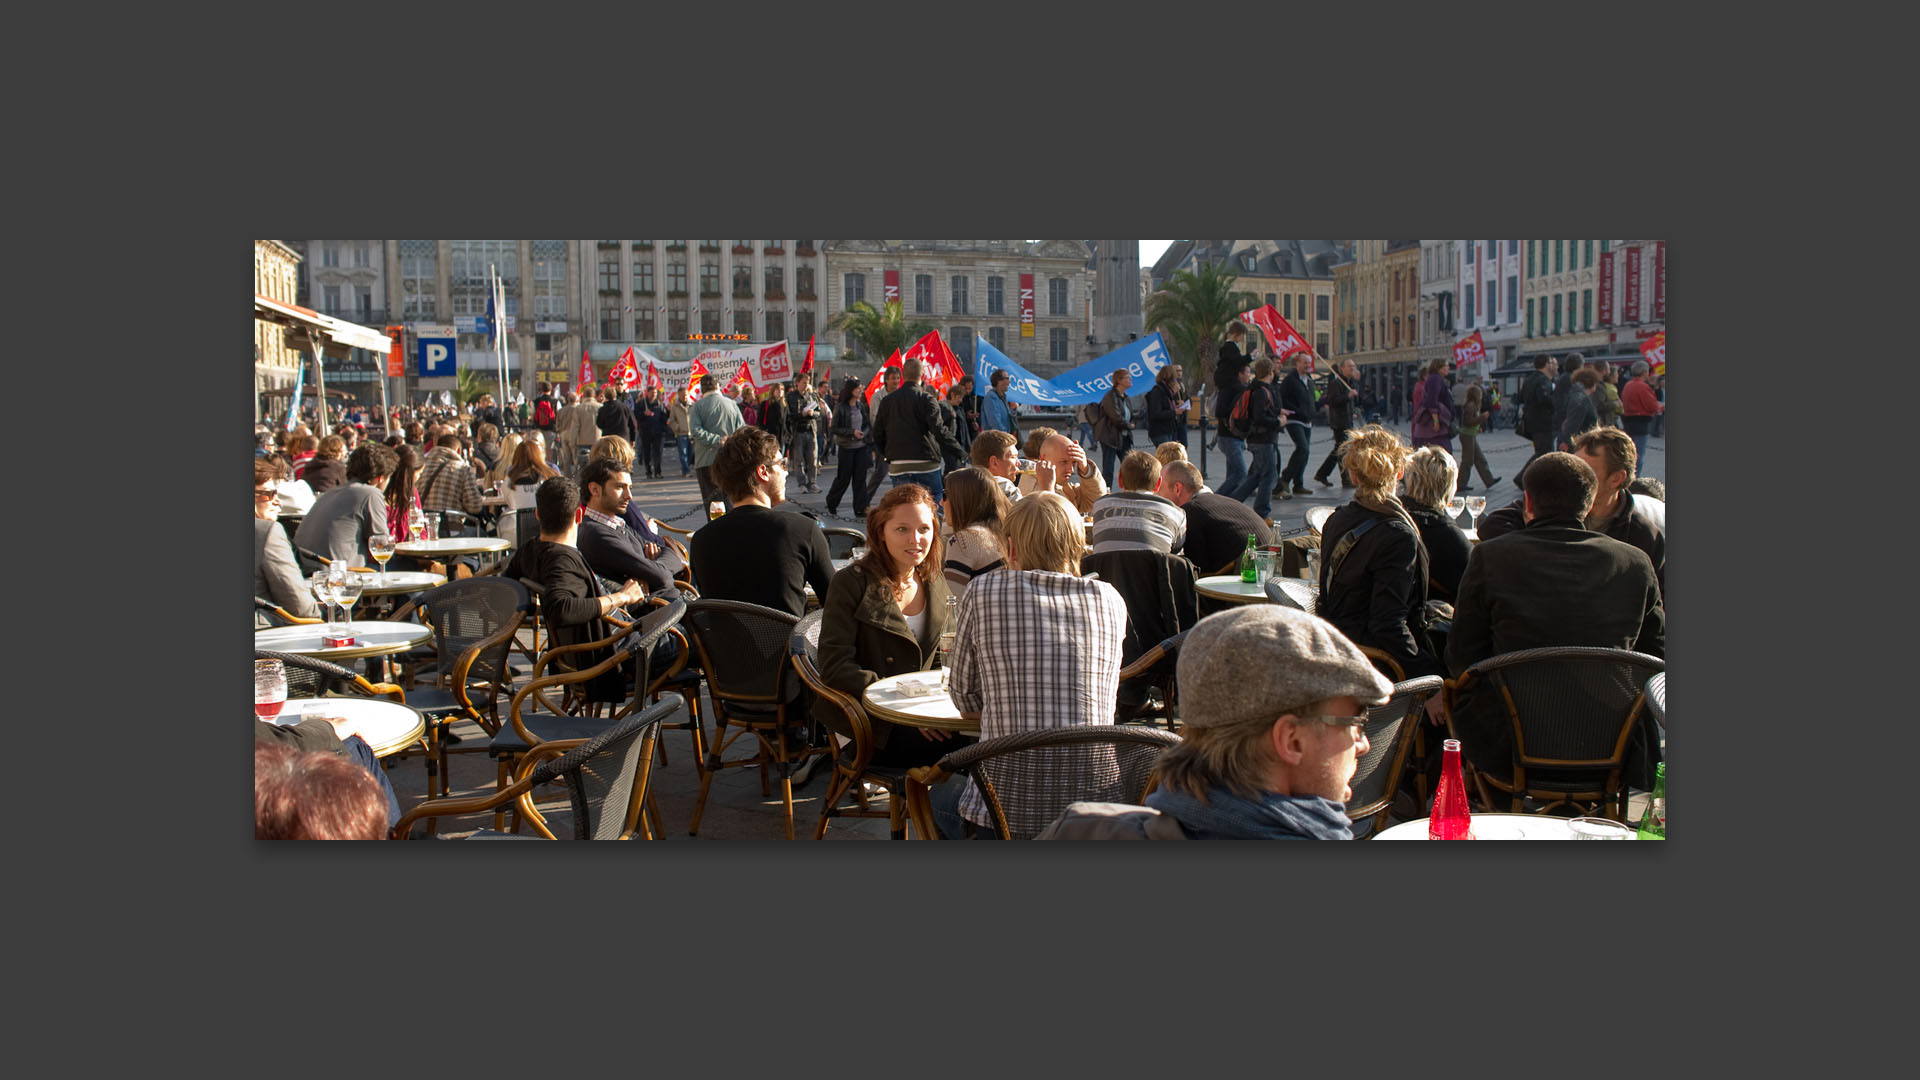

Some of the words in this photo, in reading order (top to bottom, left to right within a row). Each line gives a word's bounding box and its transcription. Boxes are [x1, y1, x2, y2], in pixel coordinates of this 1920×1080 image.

[688, 333, 748, 341] 16:17:32
[426, 343, 448, 371] P
[761, 352, 788, 372] cgt
